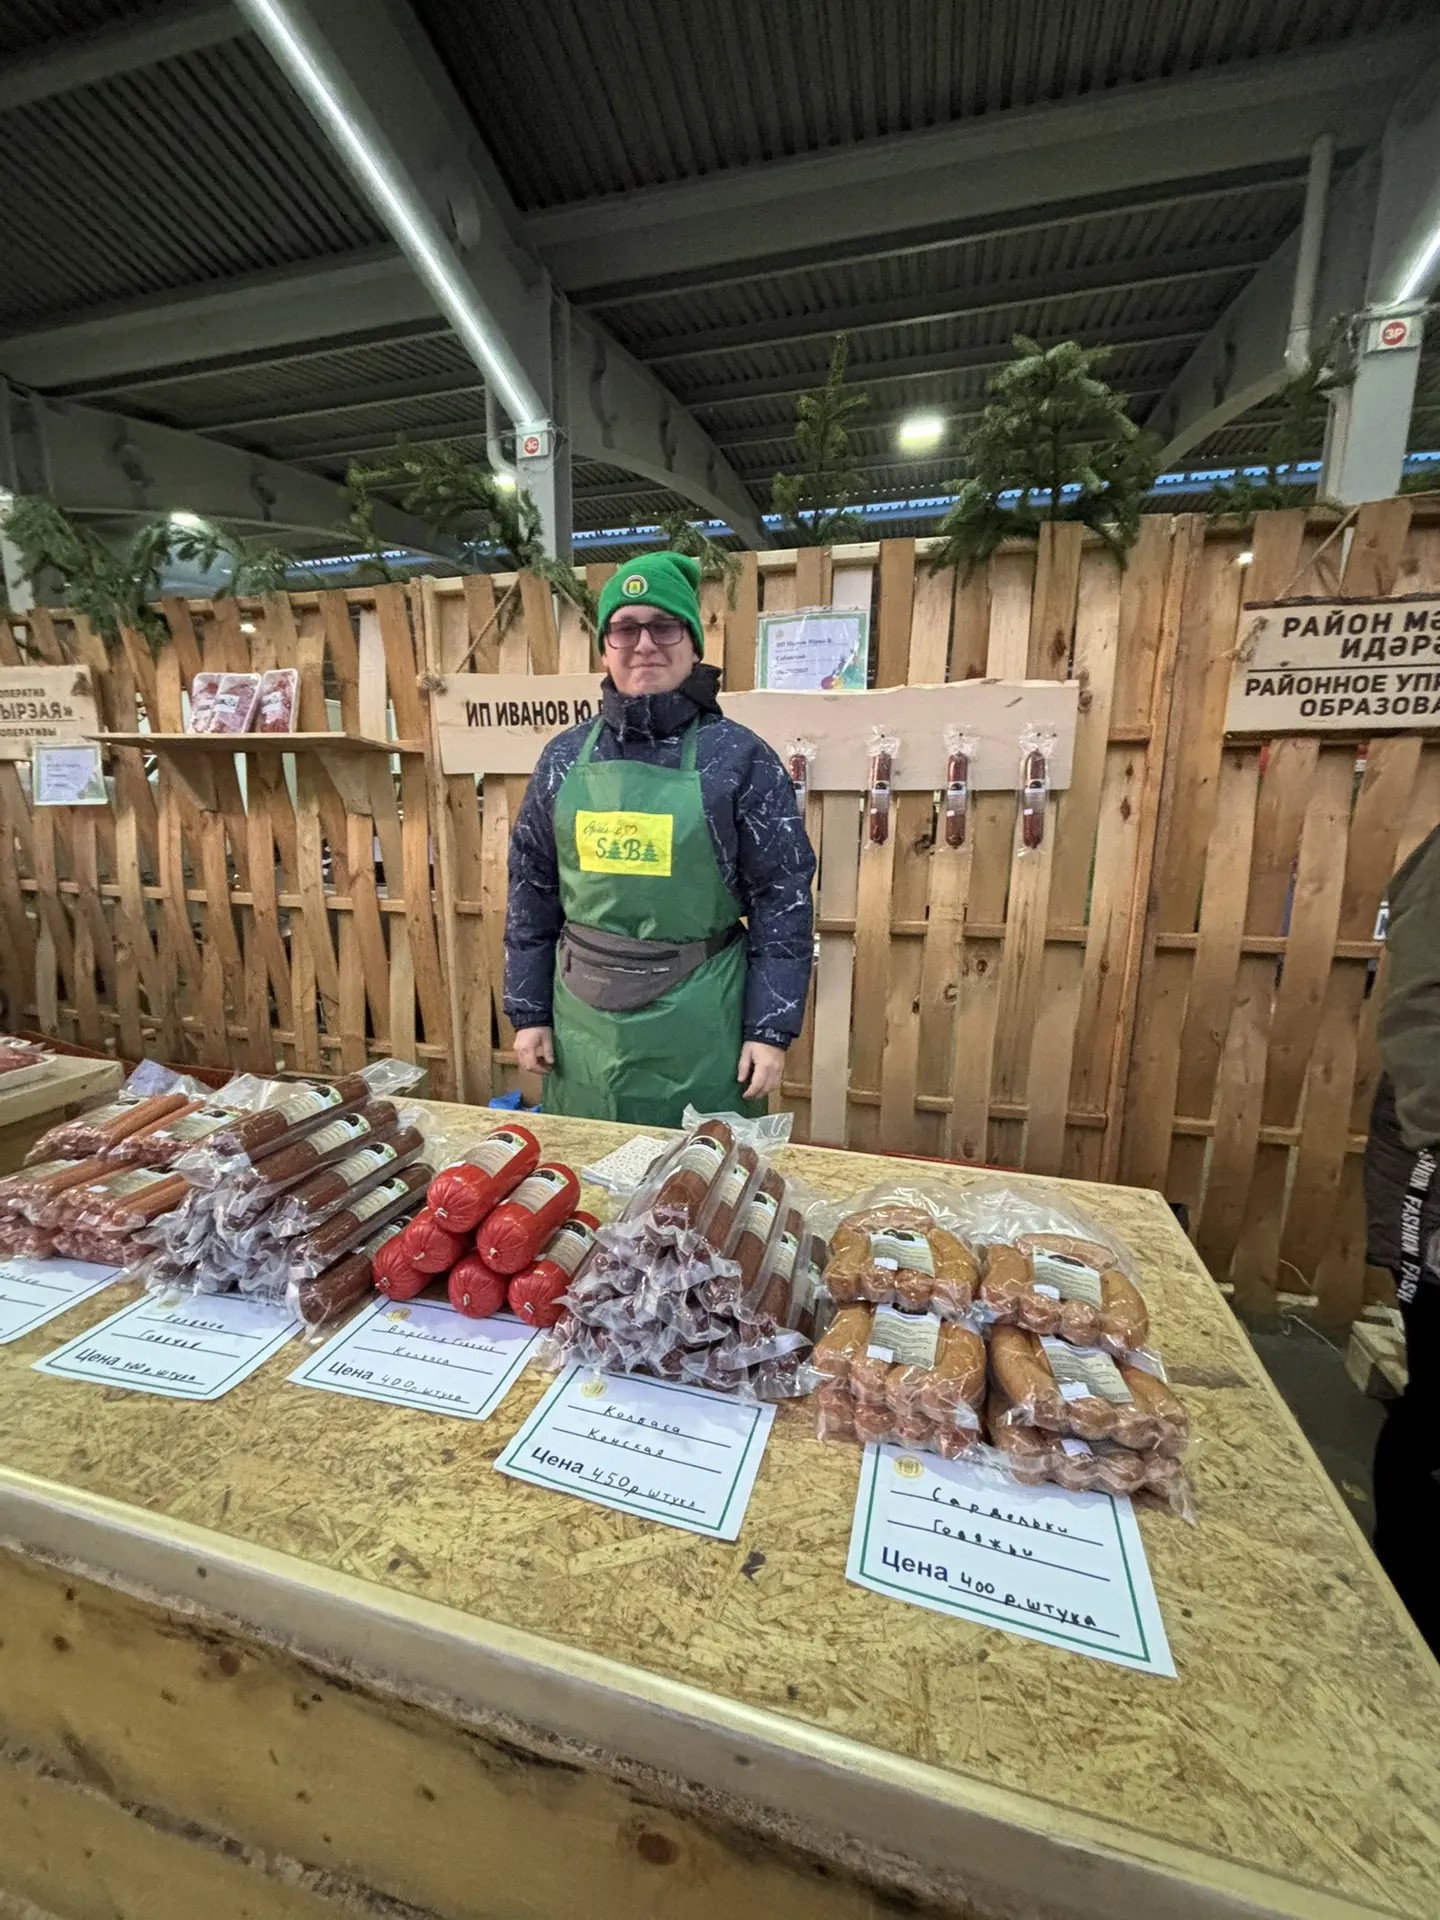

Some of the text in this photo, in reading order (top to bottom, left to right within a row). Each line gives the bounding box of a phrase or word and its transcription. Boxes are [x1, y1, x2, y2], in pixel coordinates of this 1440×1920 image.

[1282, 609, 1393, 638] РАЙОН
[1245, 673, 1388, 696] РАЙОННОЕ
[466, 701, 491, 727] ИП
[496, 700, 569, 727] ИВАНОВ
[1401, 1195, 1423, 1257] FASHION
[74, 1348, 120, 1367] Цена
[327, 1360, 374, 1381] Цена
[603, 1404, 681, 1434] Колбаса
[586, 1427, 665, 1458] Конская
[531, 1447, 585, 1475] Цена
[648, 1489, 696, 1511] штука
[931, 1486, 1068, 1534] Сардельки
[932, 1518, 1033, 1558] Говяжьи
[881, 1545, 949, 1583] Цена
